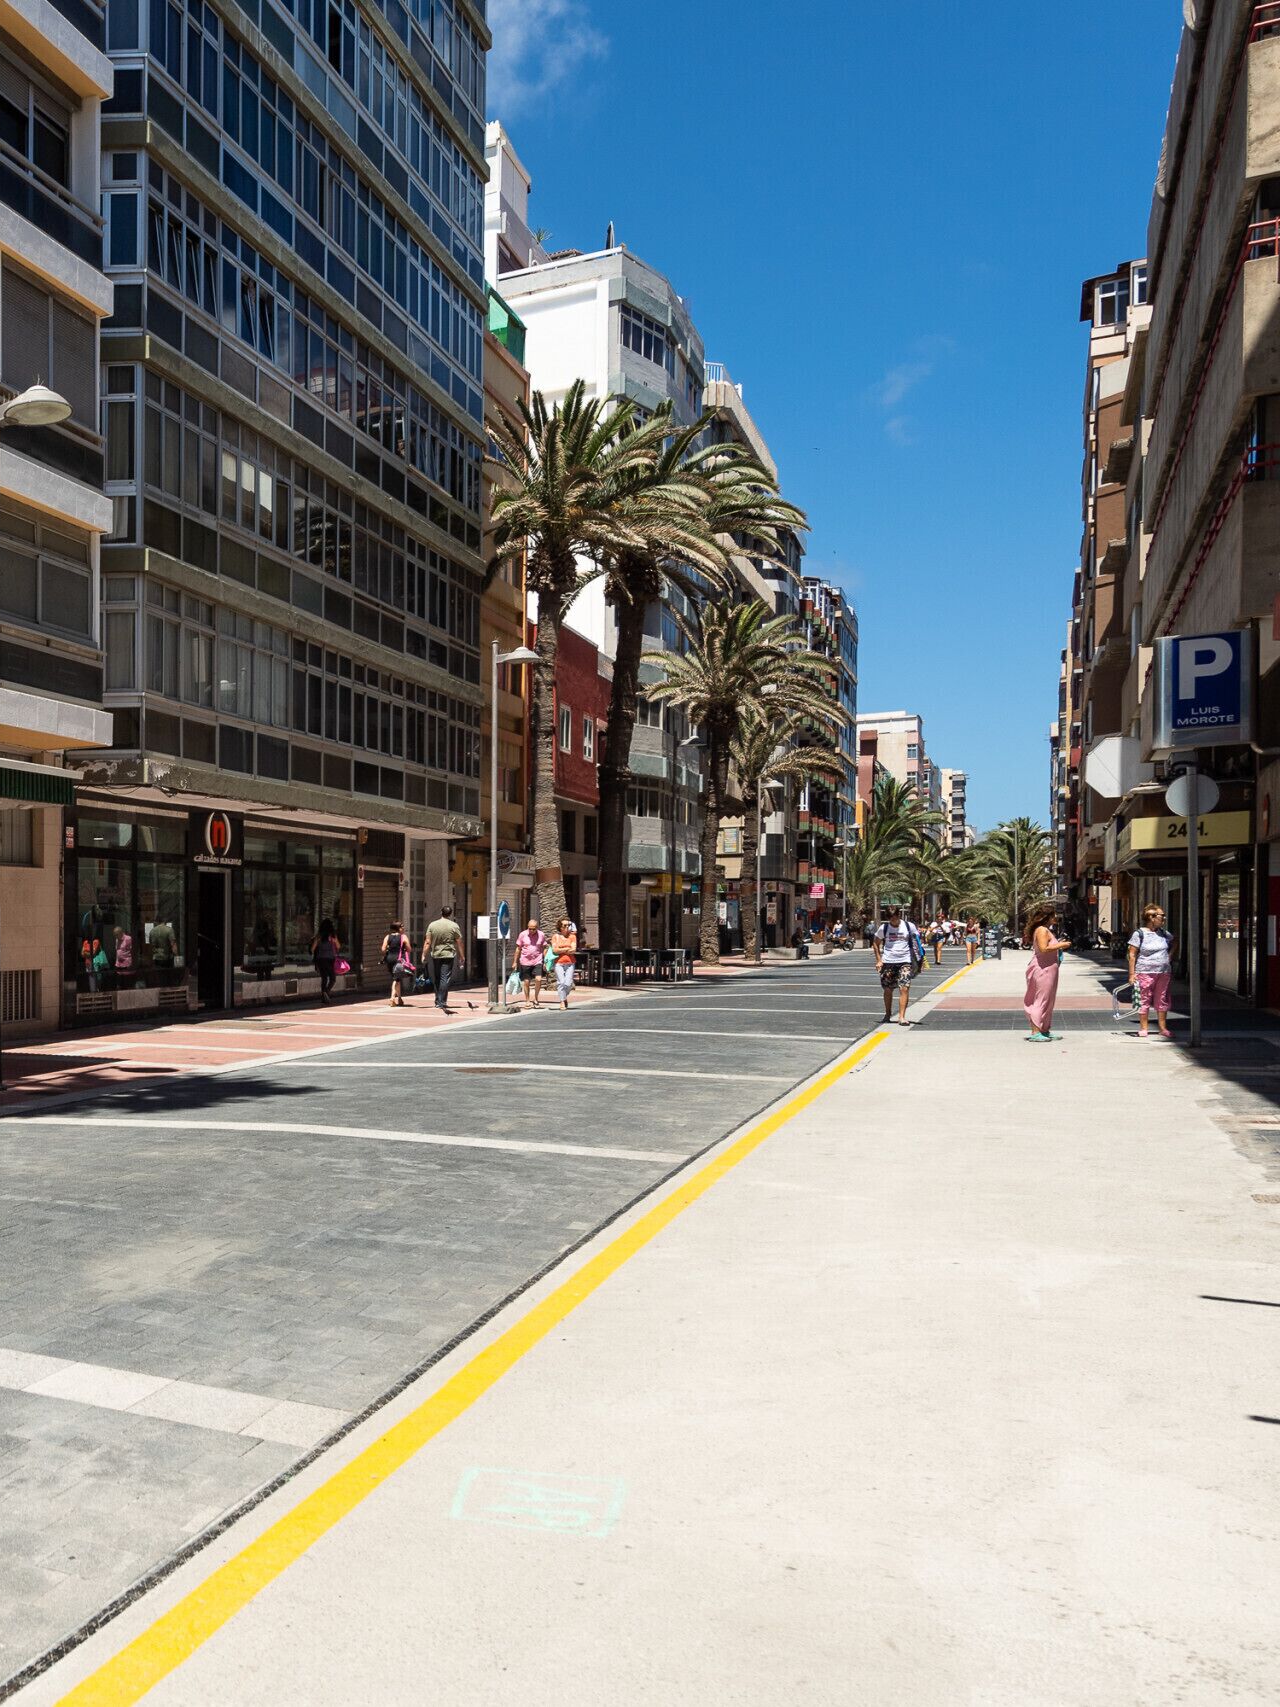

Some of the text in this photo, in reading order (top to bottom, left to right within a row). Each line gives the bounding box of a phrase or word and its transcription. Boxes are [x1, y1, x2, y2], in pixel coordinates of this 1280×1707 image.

[1179, 638, 1233, 700] P
[1191, 706, 1220, 715] LUIS
[1177, 714, 1234, 725] MOROTE
